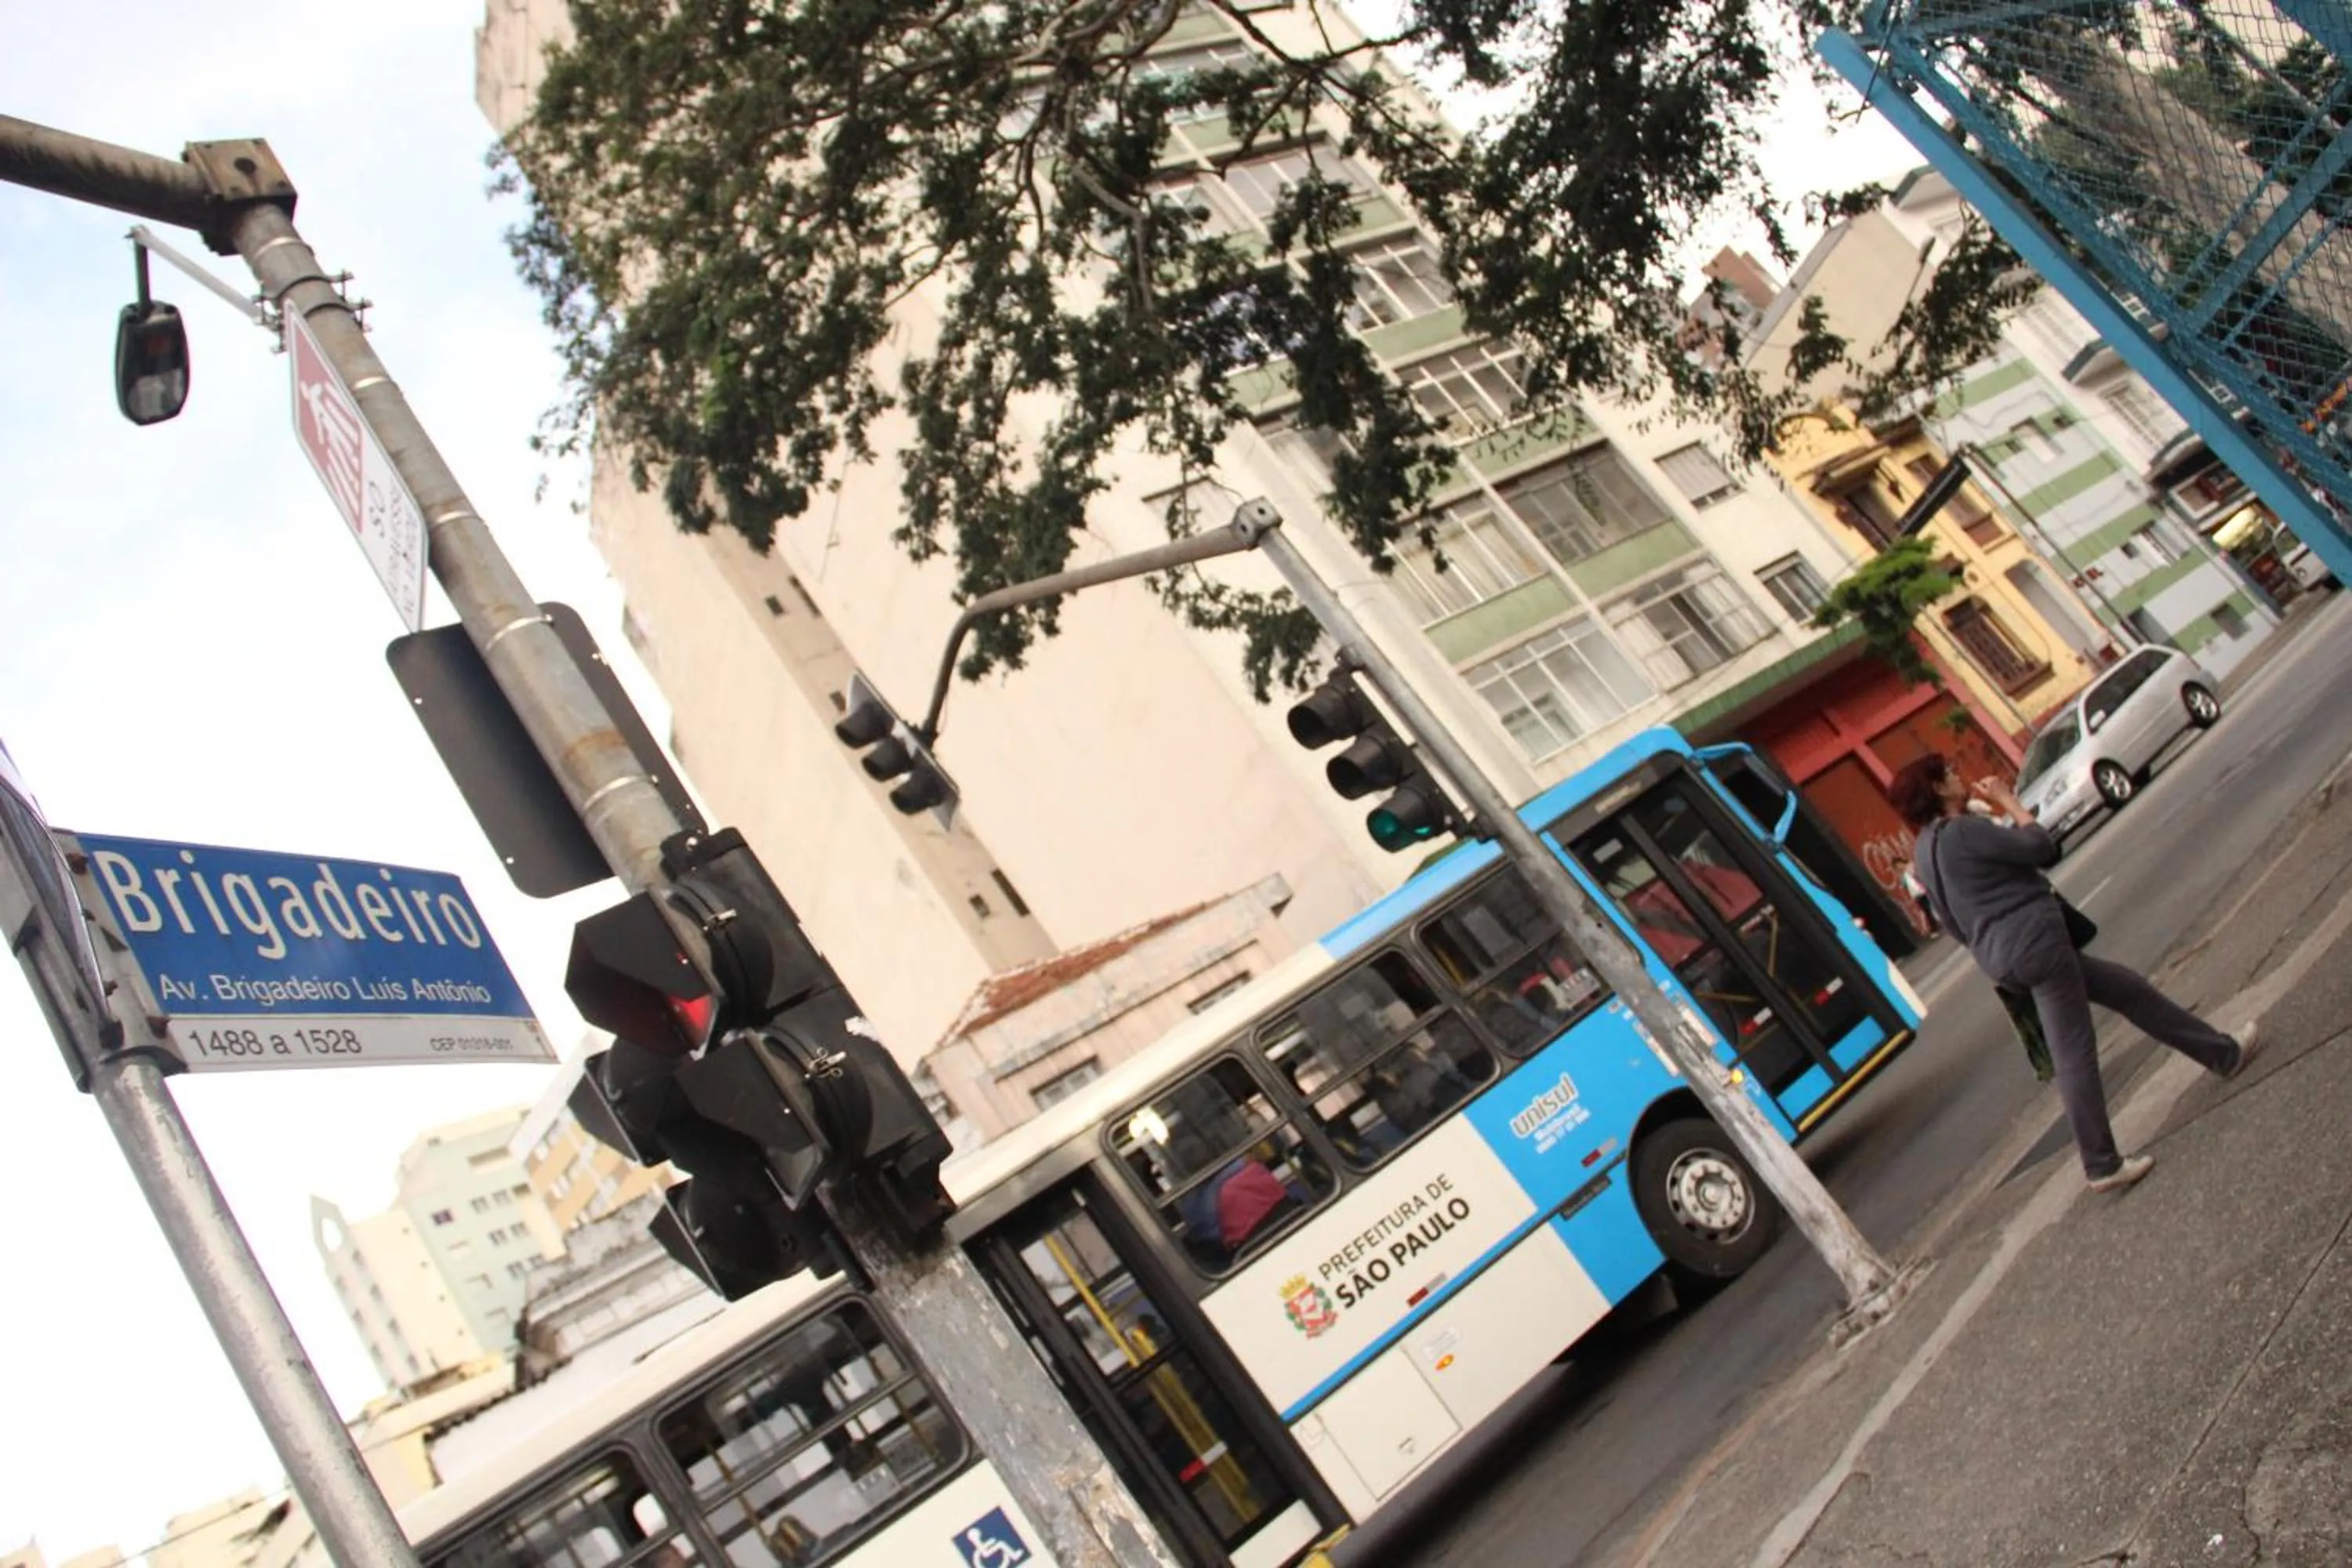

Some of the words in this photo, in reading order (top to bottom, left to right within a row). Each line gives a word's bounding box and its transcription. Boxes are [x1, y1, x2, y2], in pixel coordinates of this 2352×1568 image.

[93, 849, 481, 960] Brigadeiro
[159, 975, 208, 1000] Av.
[210, 974, 350, 1007] Brigadeiro
[356, 976, 408, 1001] Luís
[412, 978, 492, 1004] Antônio
[189, 1029, 267, 1057] 1488
[272, 1036, 291, 1054] a
[293, 1029, 362, 1054] 1528
[1510, 1072, 1578, 1138] unisul
[1319, 1193, 1424, 1282] PREFEITURA
[1425, 1173, 1454, 1201] DE
[1336, 1262, 1392, 1309] SÃO
[1392, 1197, 1471, 1269] PAULO
